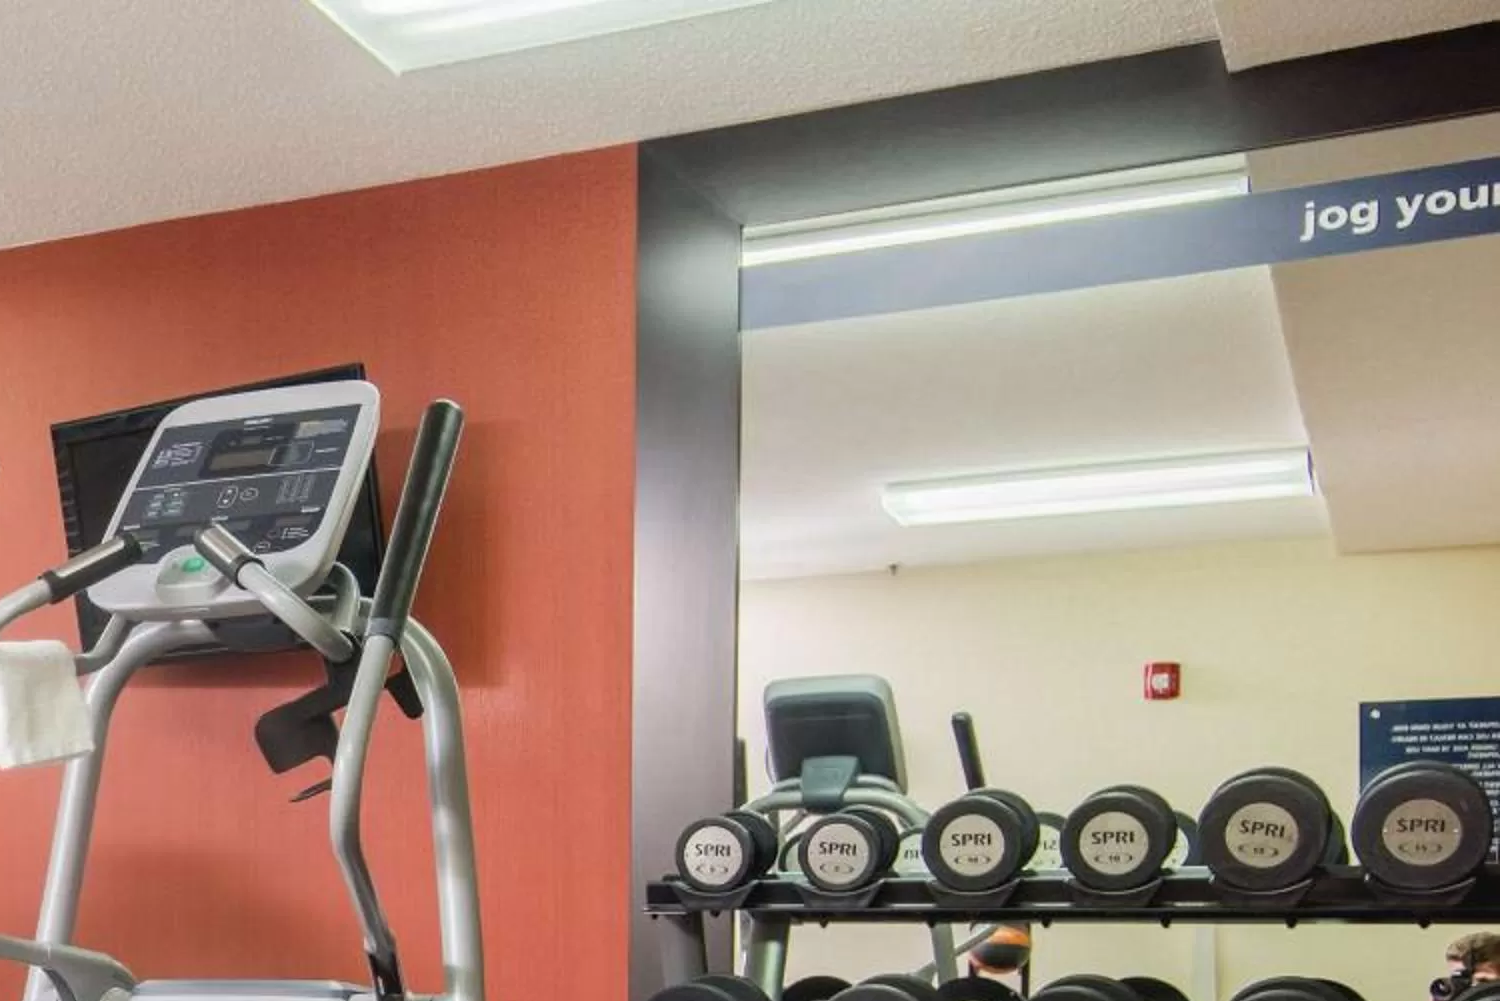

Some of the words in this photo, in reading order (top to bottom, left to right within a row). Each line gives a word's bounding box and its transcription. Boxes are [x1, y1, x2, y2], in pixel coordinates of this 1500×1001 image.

[1300, 200, 1380, 243] jog
[1239, 819, 1286, 839] SPRI
[1396, 818, 1446, 833] SPRI
[950, 833, 992, 847] SPRI
[1091, 831, 1136, 845] SPRI
[695, 843, 731, 857] SPRI
[819, 841, 858, 856] SPRI
